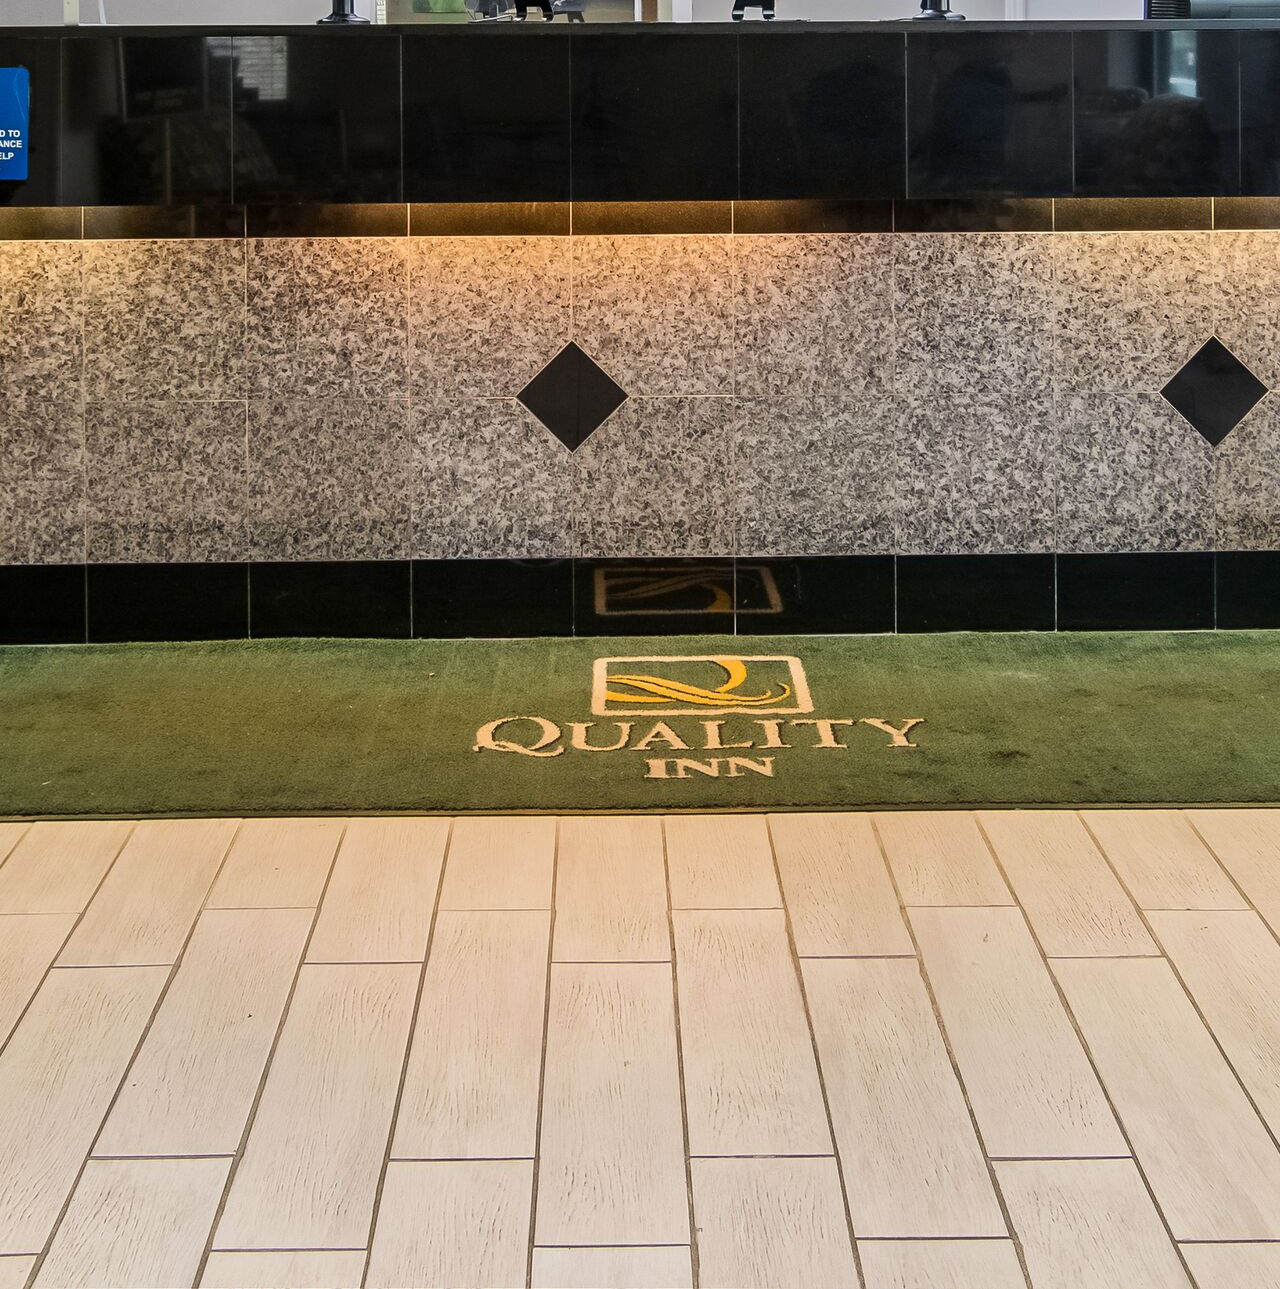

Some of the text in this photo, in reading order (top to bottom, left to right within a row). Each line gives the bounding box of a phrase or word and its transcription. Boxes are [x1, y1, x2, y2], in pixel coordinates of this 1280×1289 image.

[7, 129, 21, 138] TO
[472, 715, 925, 757] QUALITY
[644, 757, 775, 779] INN
